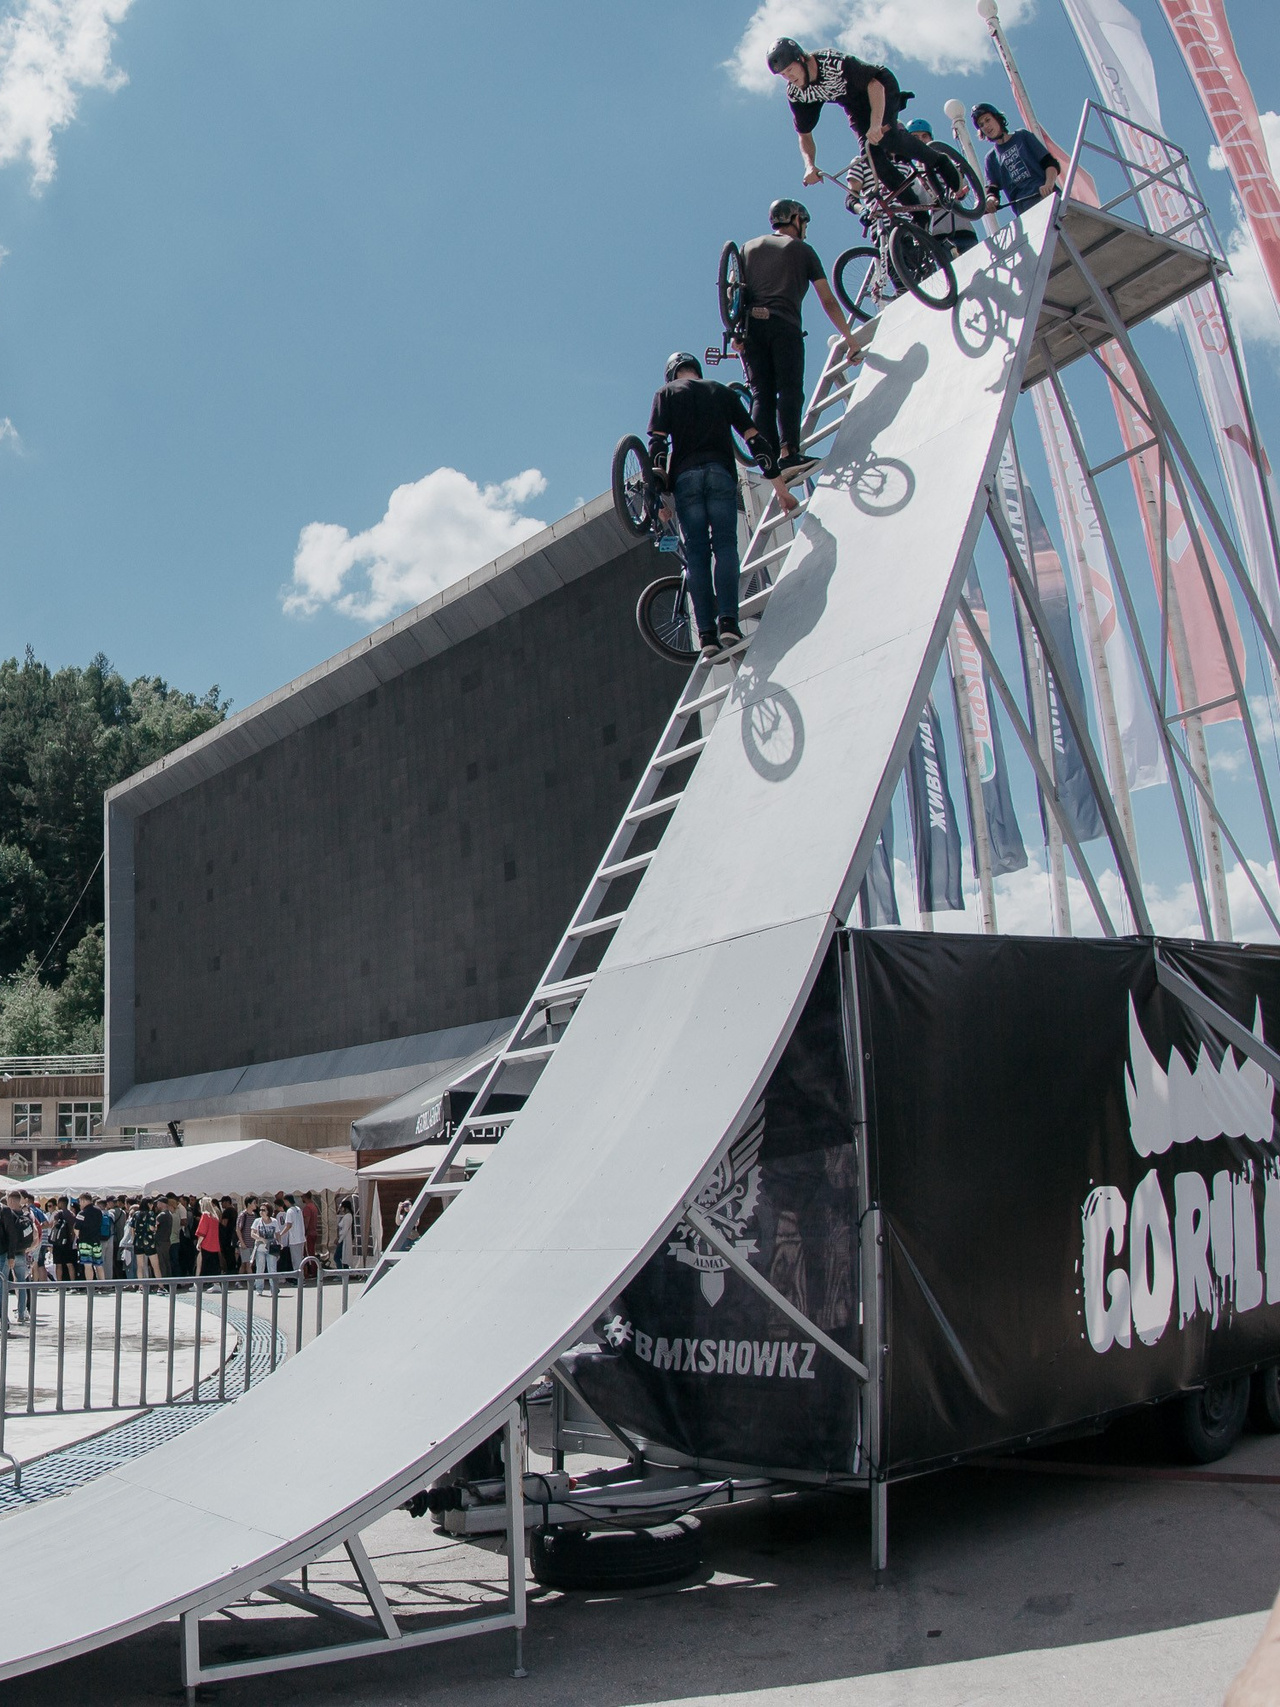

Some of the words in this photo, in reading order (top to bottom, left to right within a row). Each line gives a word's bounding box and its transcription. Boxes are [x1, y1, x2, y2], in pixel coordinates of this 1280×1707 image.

[918, 720, 935, 754] НА
[923, 756, 947, 834] ЖИВИ
[693, 1258, 724, 1268] ALMAT
[604, 1315, 816, 1379] #BMXSHOWKZ
